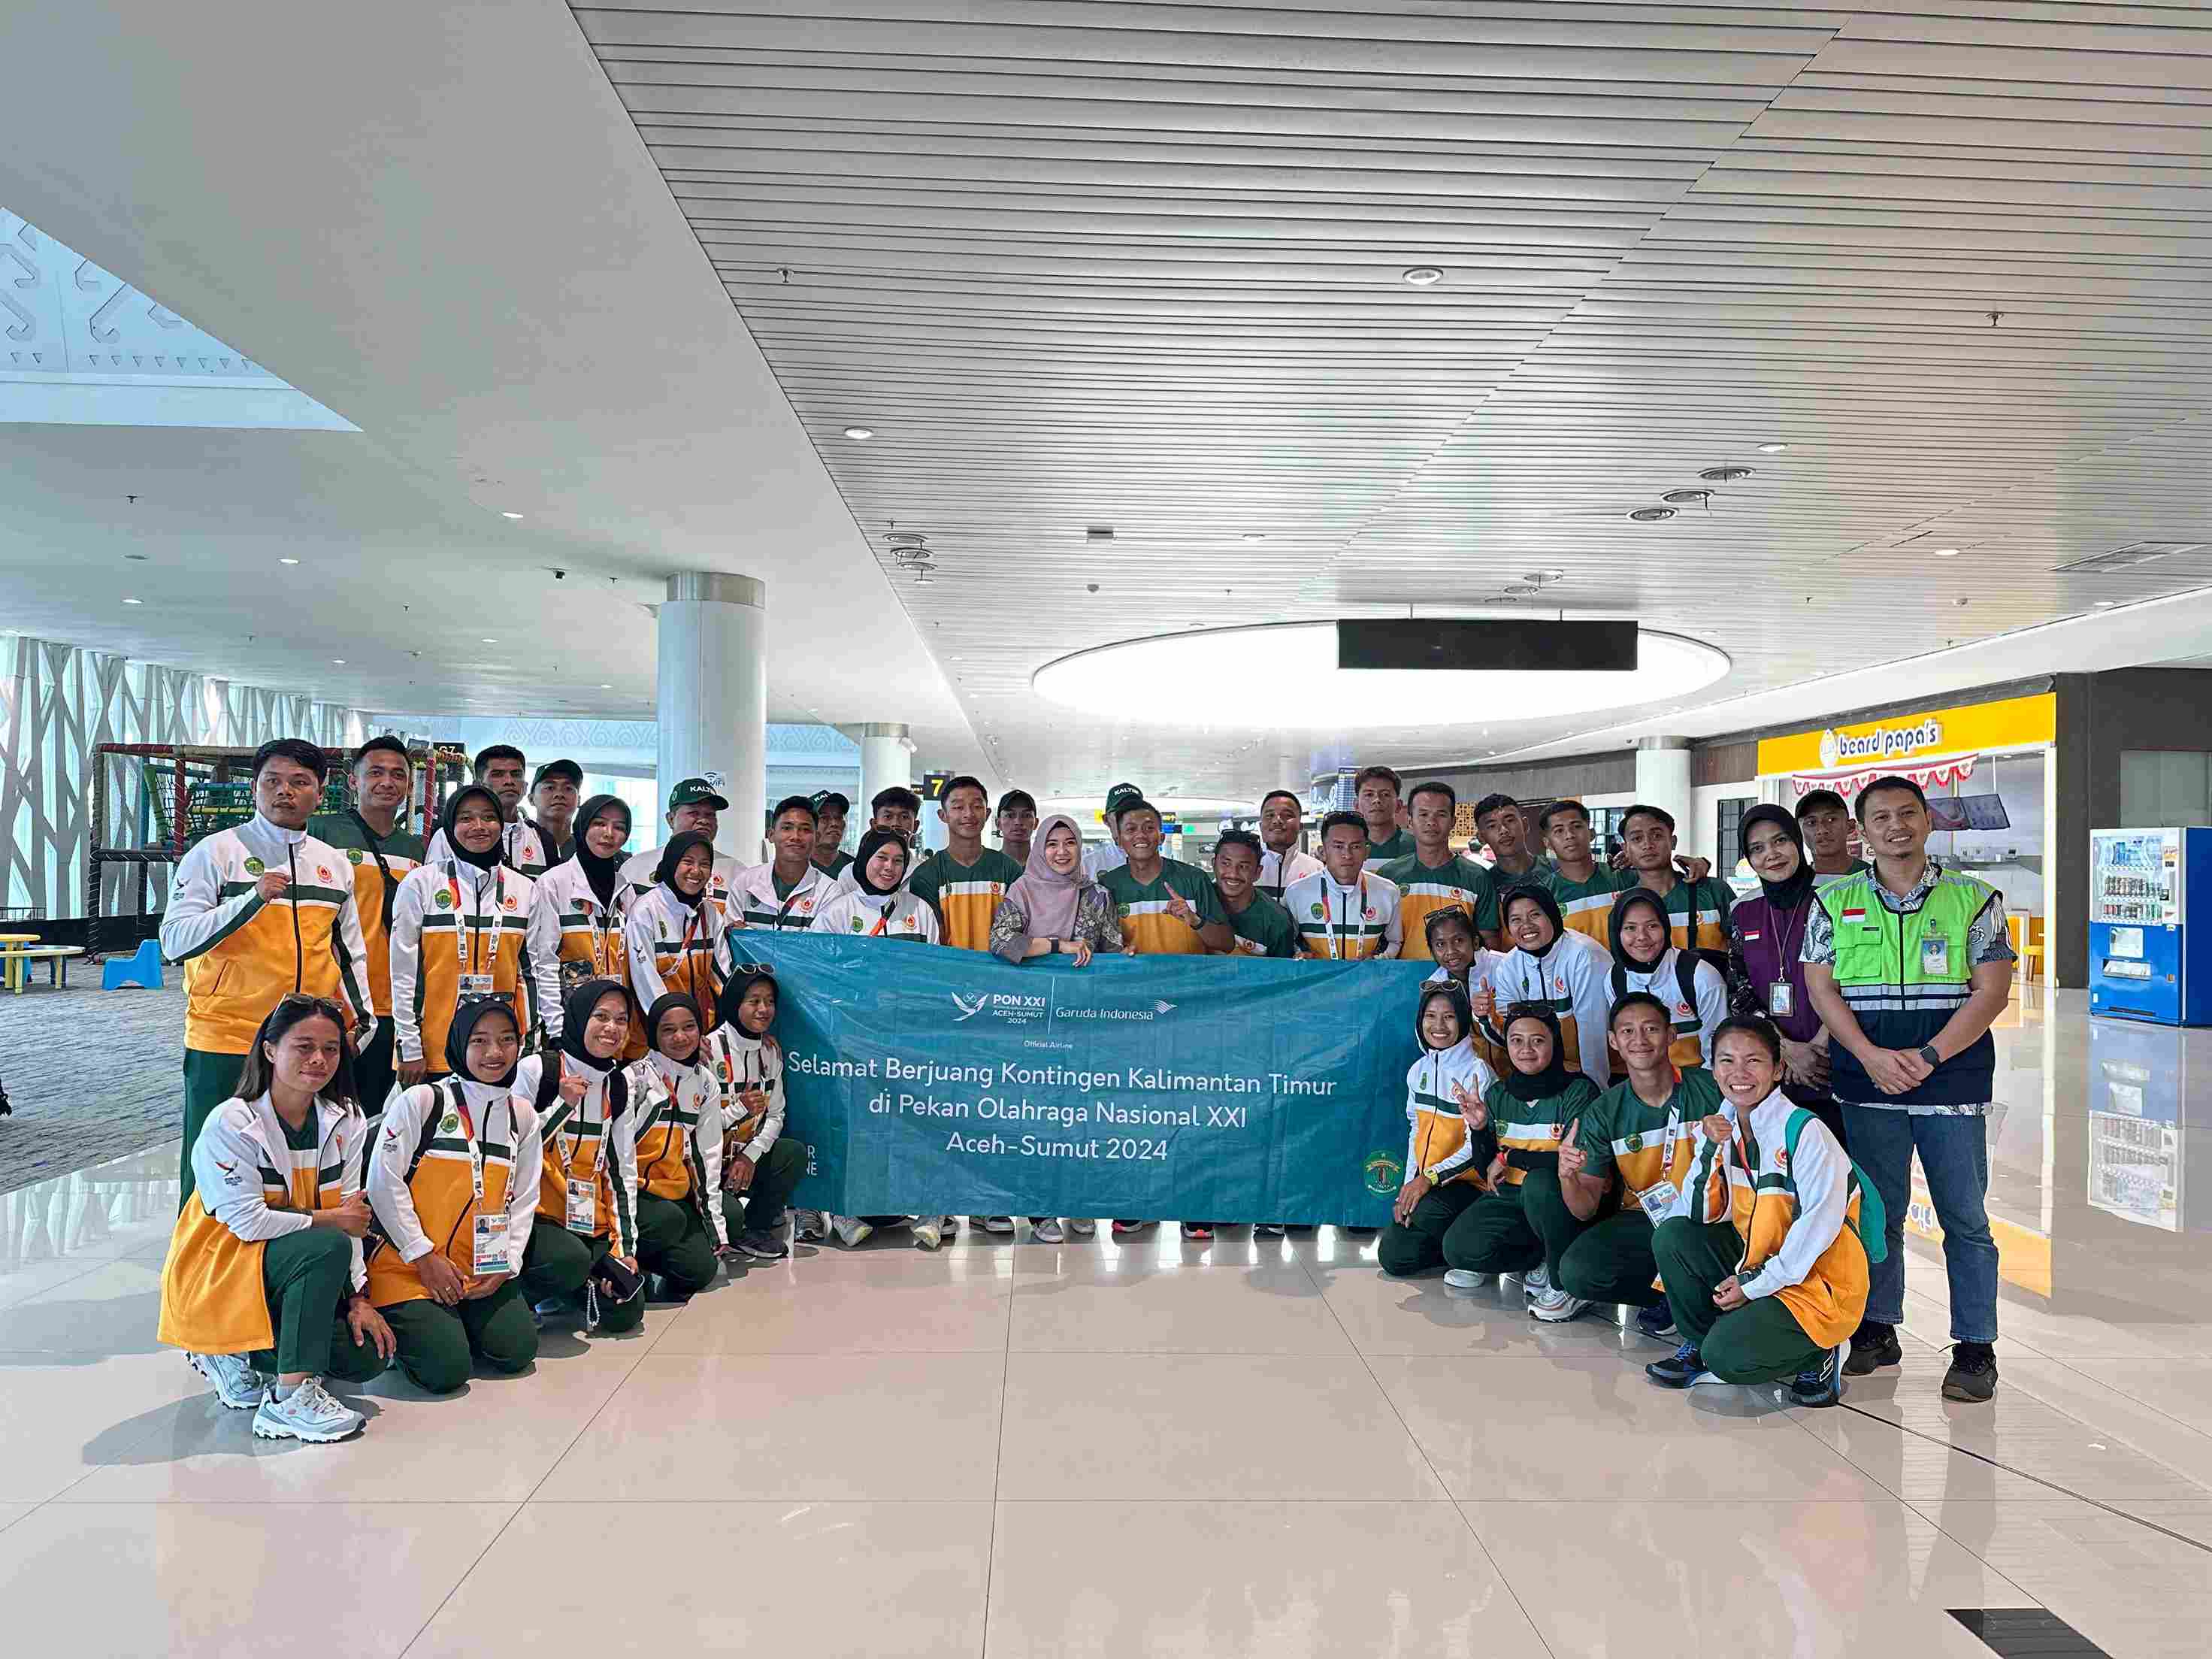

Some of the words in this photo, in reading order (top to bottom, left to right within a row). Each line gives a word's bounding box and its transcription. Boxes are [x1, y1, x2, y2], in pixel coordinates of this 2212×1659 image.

[1839, 731, 1881, 755] beard
[1884, 722, 1937, 755] papa's
[931, 779, 945, 797] 7
[993, 994, 1021, 1006] PON
[1024, 996, 1045, 1007] XXI
[992, 1010, 1044, 1018] ACEH-SUMUT
[1055, 1007, 1097, 1019] Garuda
[1100, 1008, 1154, 1021] Indonesia
[1023, 1040, 1049, 1048] Official
[788, 1052, 878, 1078] Selamat
[885, 1057, 994, 1089] Berjuang
[1000, 1062, 1121, 1092] Kontingen
[1128, 1067, 1261, 1094] Kalimantan
[1268, 1073, 1338, 1095] Timur
[869, 1088, 891, 1114] di
[899, 1094, 970, 1119] Pekan
[976, 1097, 1089, 1128] Olahraga
[1095, 1100, 1200, 1128] Nasional
[1206, 1106, 1247, 1129] XXI
[946, 1131, 1100, 1161] Aceh-Sumut
[1105, 1137, 1168, 1161] 2024
